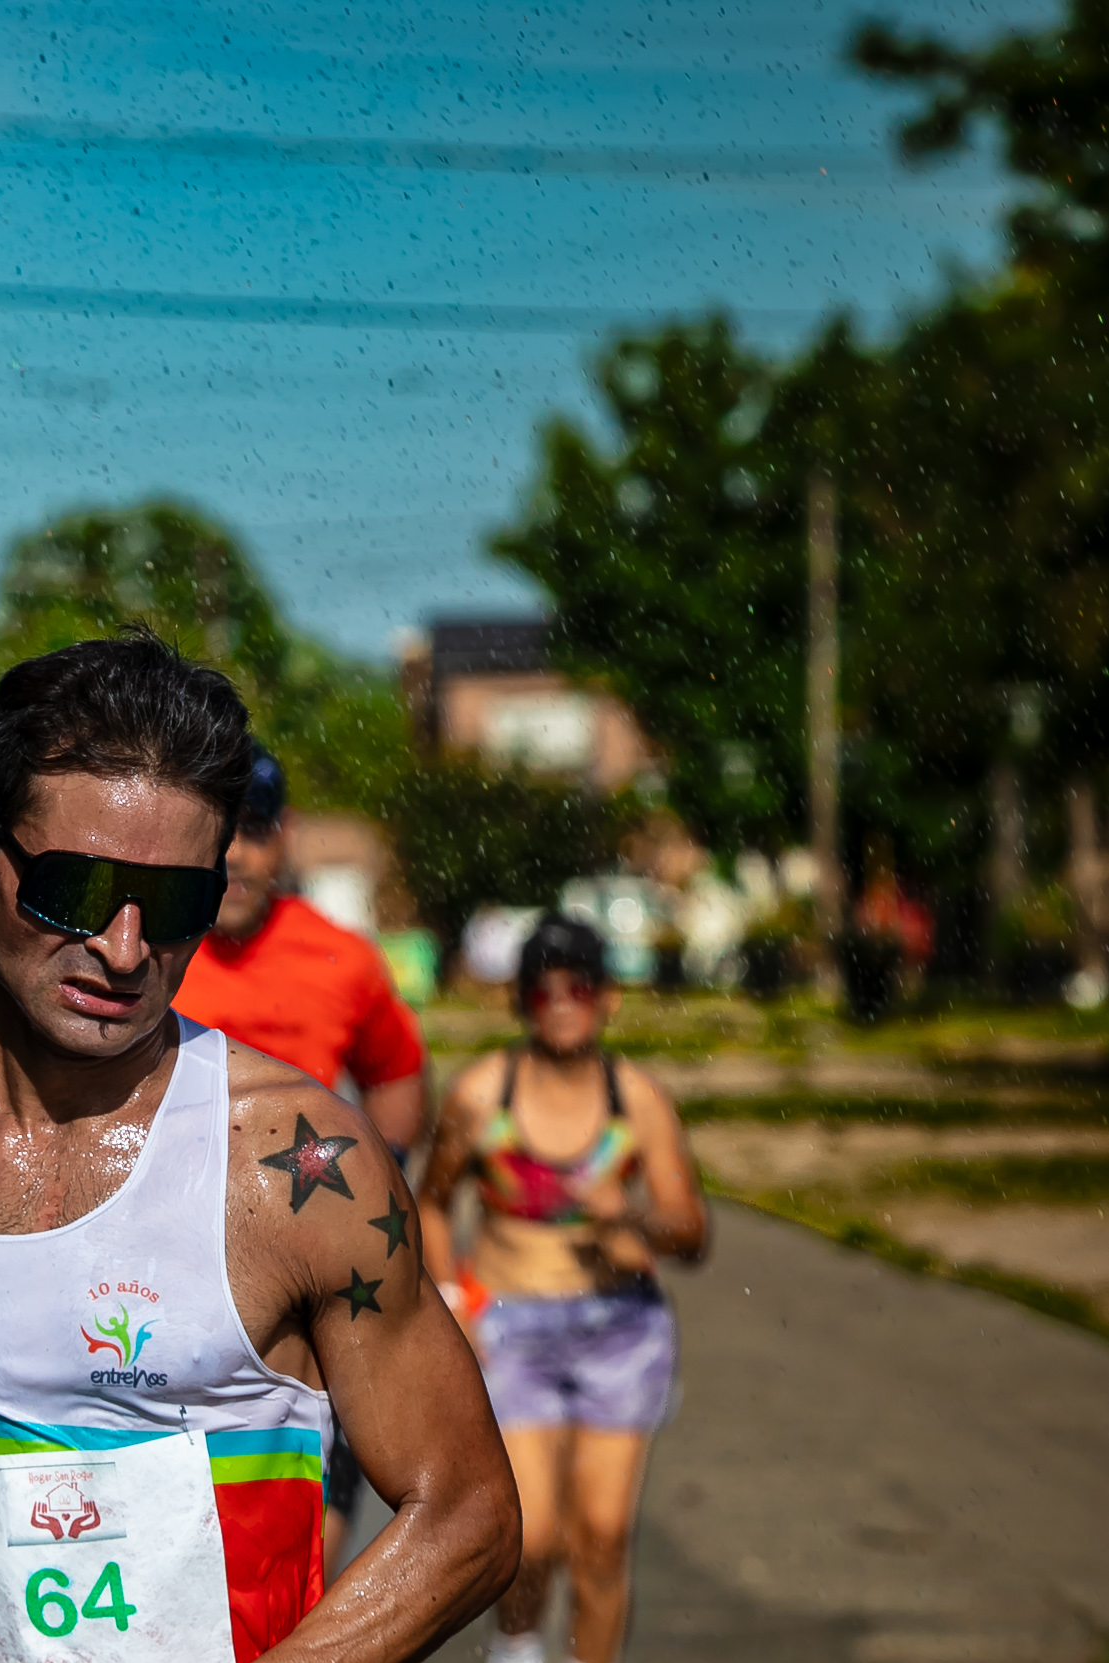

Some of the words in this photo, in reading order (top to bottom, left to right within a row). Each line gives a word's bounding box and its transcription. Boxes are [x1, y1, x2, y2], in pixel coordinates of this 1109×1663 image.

[88, 1282, 110, 1301] 10
[117, 1280, 160, 1304] años
[55, 1471, 69, 1482] San
[25, 1561, 137, 1637] 64
